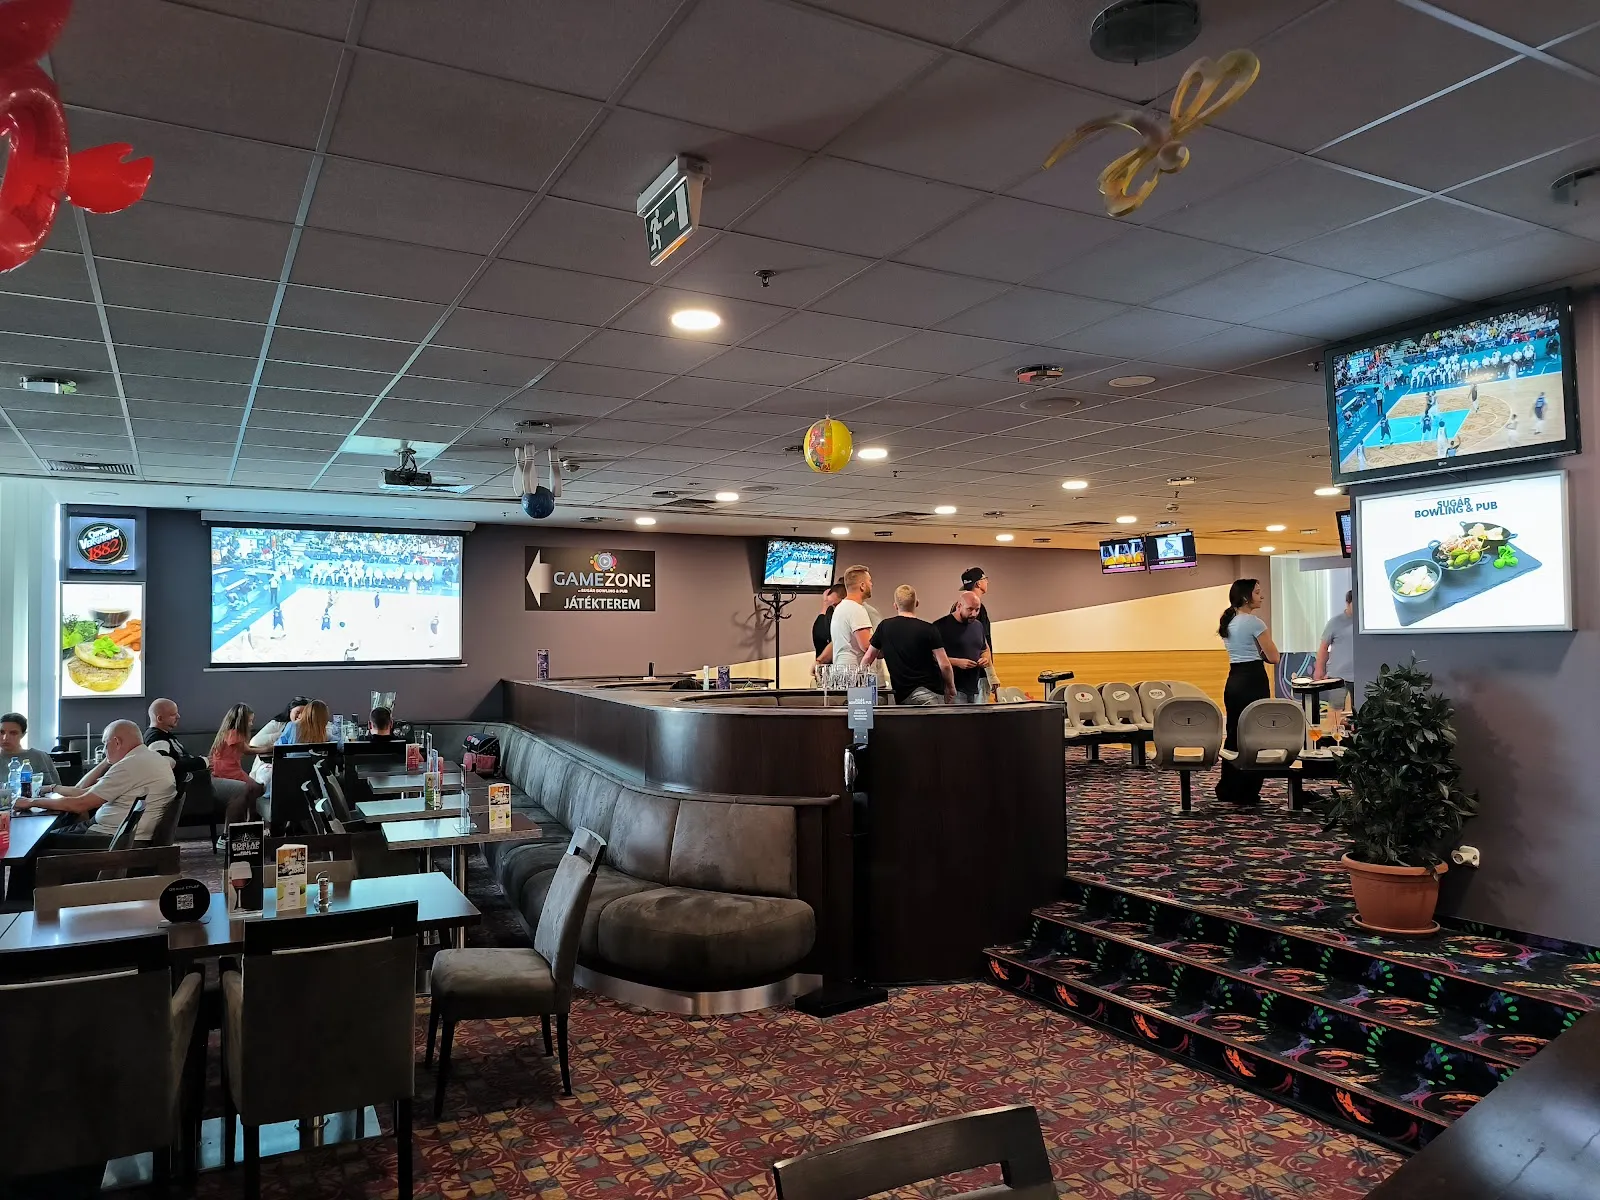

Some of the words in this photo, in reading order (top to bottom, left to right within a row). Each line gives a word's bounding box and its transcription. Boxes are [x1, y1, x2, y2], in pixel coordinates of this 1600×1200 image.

[1414, 505, 1464, 518] BOWLING
[1466, 503, 1474, 512] &
[1476, 501, 1498, 511] PUB
[1437, 497, 1471, 508] SUGÁR
[88, 538, 120, 561] 1882
[553, 571, 651, 588] GAMEZONE
[564, 595, 640, 610] JÁTÉKTEREM
